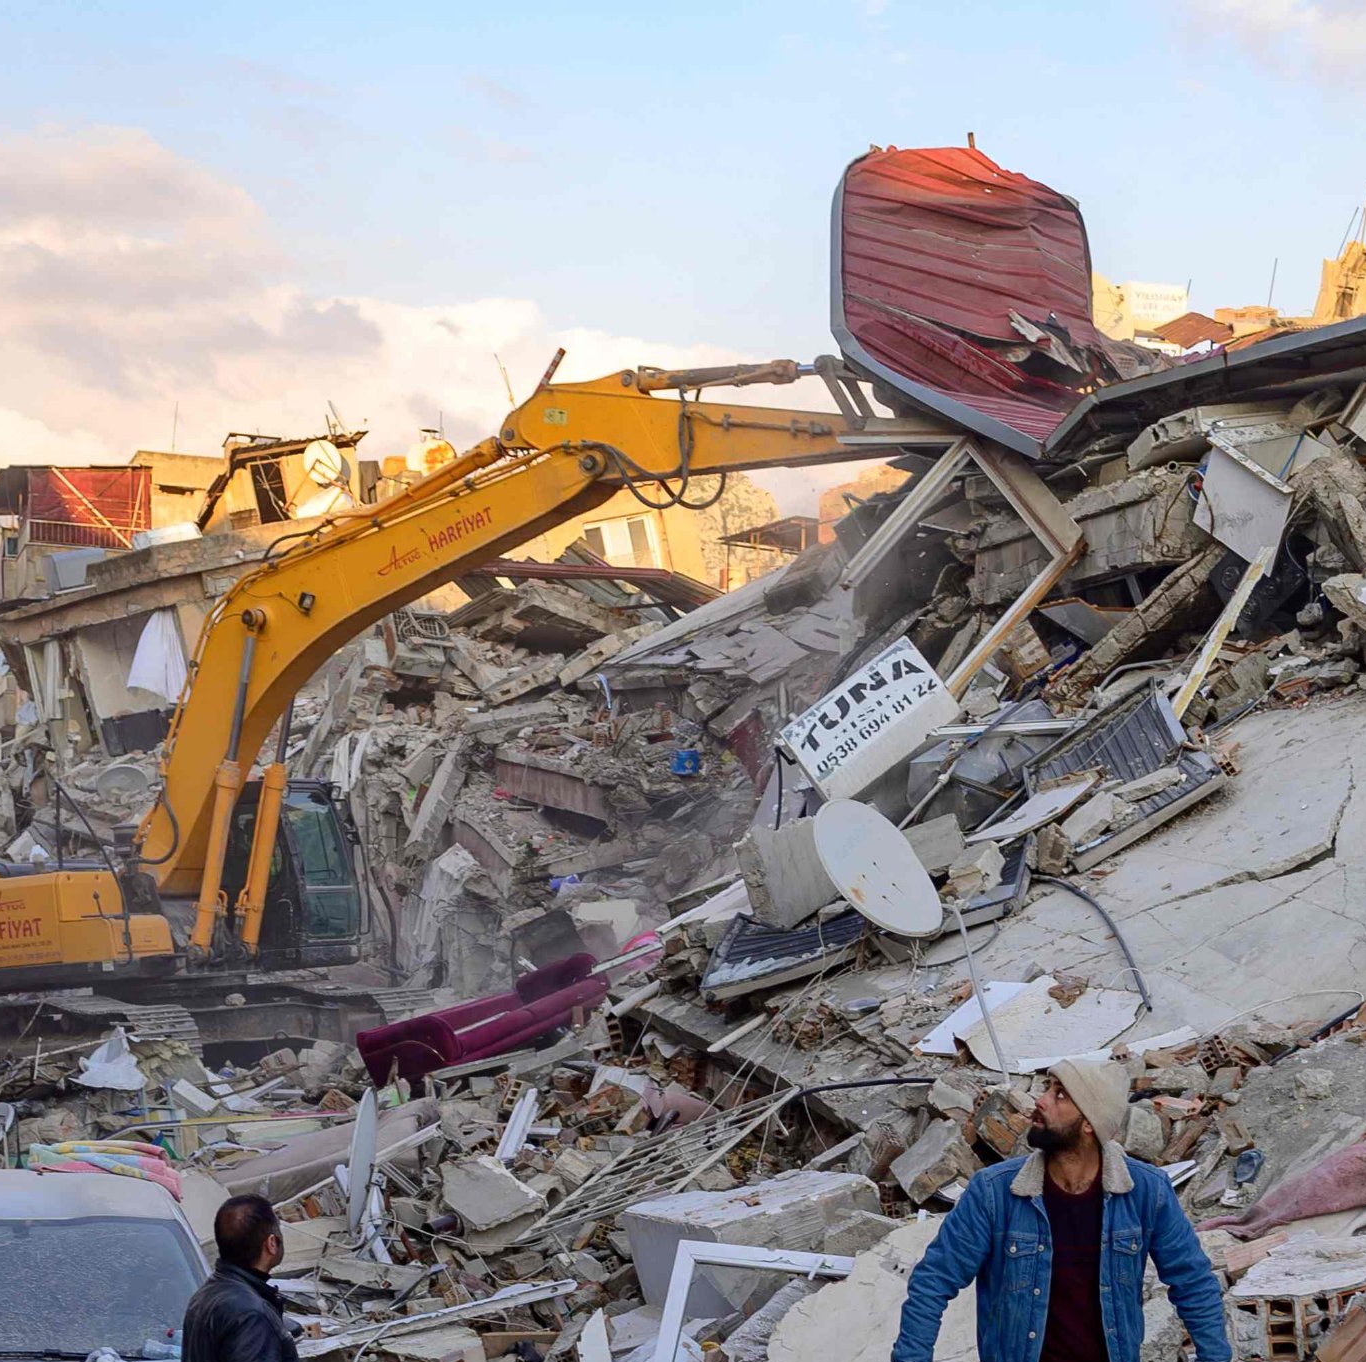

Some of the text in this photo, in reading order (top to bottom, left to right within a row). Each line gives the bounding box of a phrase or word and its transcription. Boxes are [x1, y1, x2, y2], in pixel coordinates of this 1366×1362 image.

[428, 506, 493, 552] HARFİYAT
[801, 658, 925, 753] TUNA
[815, 735, 856, 774] 0538
[859, 712, 891, 741] 694
[891, 695, 914, 716] 81
[913, 678, 938, 699] 22
